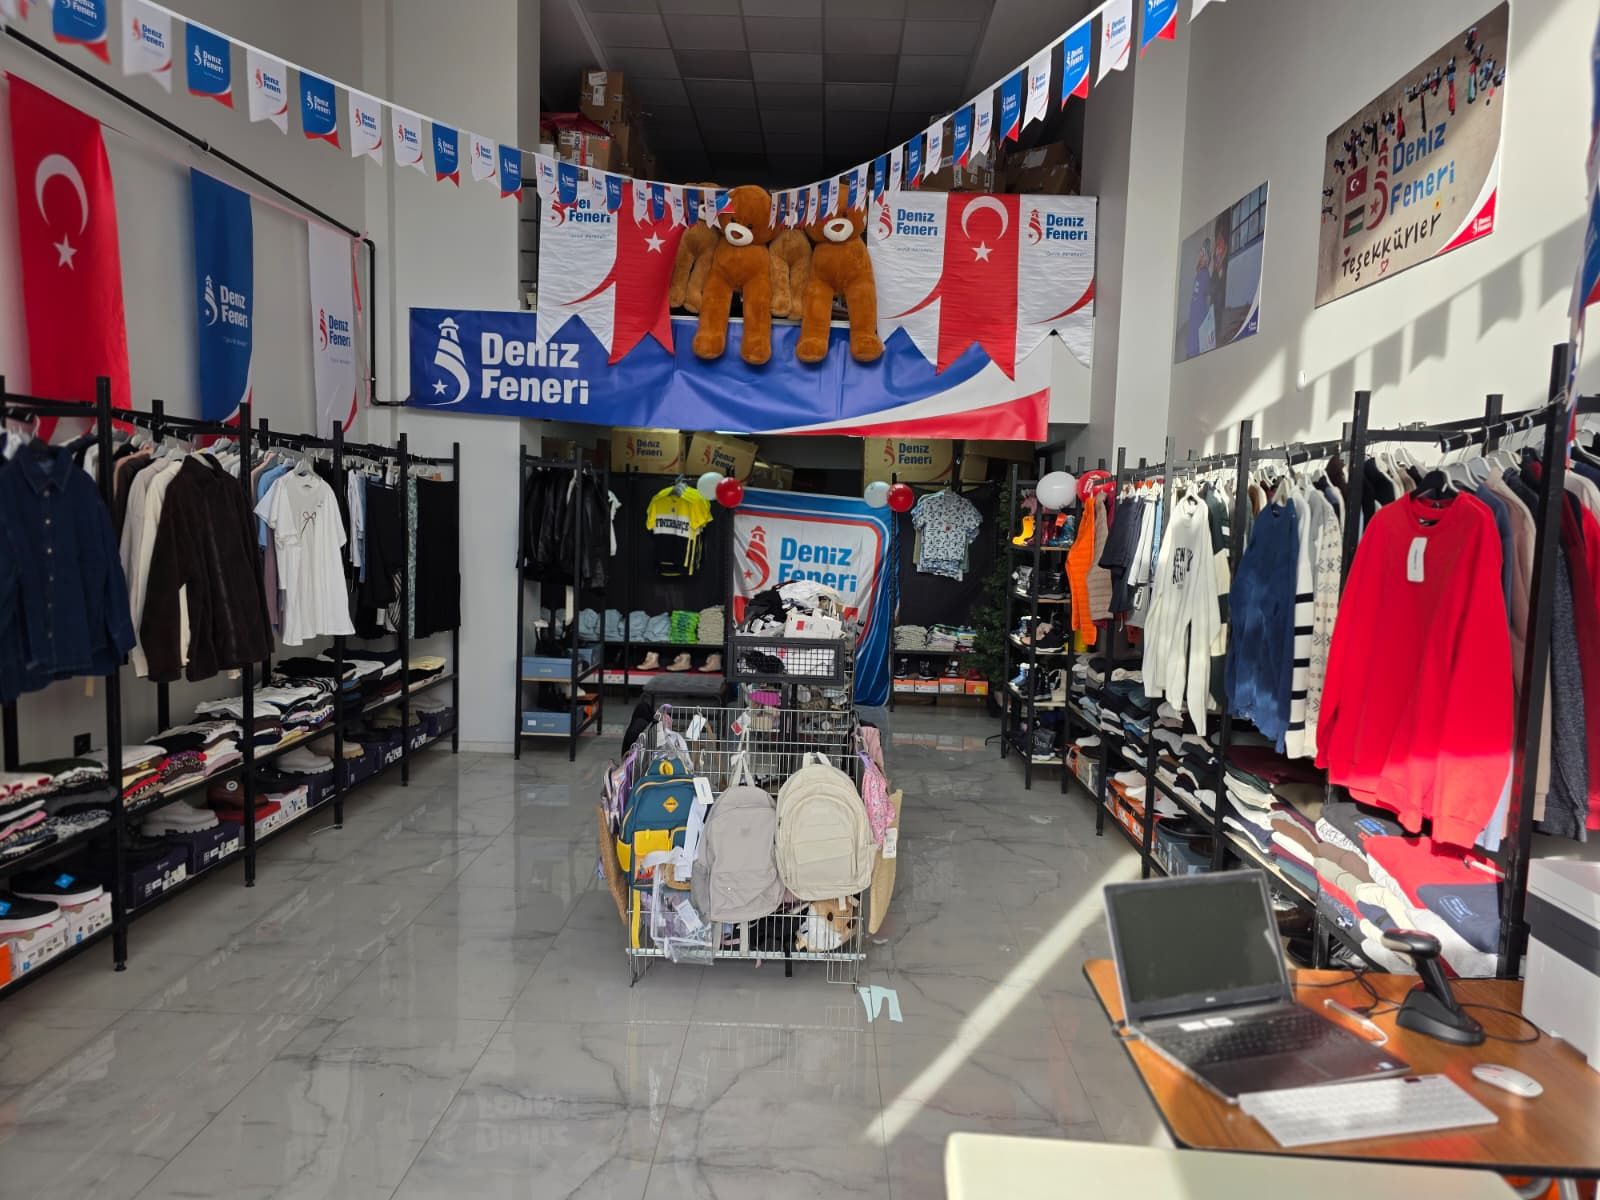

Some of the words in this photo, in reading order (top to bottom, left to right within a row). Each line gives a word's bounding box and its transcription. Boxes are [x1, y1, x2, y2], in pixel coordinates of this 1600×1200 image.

[142, 24, 162, 39] Deniz
[143, 33, 165, 48] Feneri
[203, 50, 222, 65] Deniz
[203, 60, 224, 74] Feneri
[263, 73, 280, 86] Deniz
[263, 82, 281, 94] Feneri
[313, 95, 329, 108] Deniz
[314, 103, 331, 115] Feneri
[1390, 160, 1455, 216] Feneri
[569, 209, 611, 223] Feneri
[897, 208, 935, 223] Deniz
[1046, 213, 1085, 228] Deniz
[896, 222, 938, 237] Feneri
[1045, 227, 1088, 241] Feneri
[1341, 212, 1442, 282] Teşekkürler
[219, 285, 246, 309] Deniz
[220, 304, 249, 329] Feneri
[328, 315, 349, 332] Deniz
[329, 330, 351, 348] Feneri
[481, 332, 580, 368] Deniz
[480, 368, 589, 405] Feneri
[636, 438, 660, 449] Deniz
[898, 442, 930, 454] Deniz
[636, 447, 663, 457] Feneri
[712, 449, 736, 463] Deniz
[898, 454, 932, 465] Feneri
[780, 537, 853, 567] Deniz
